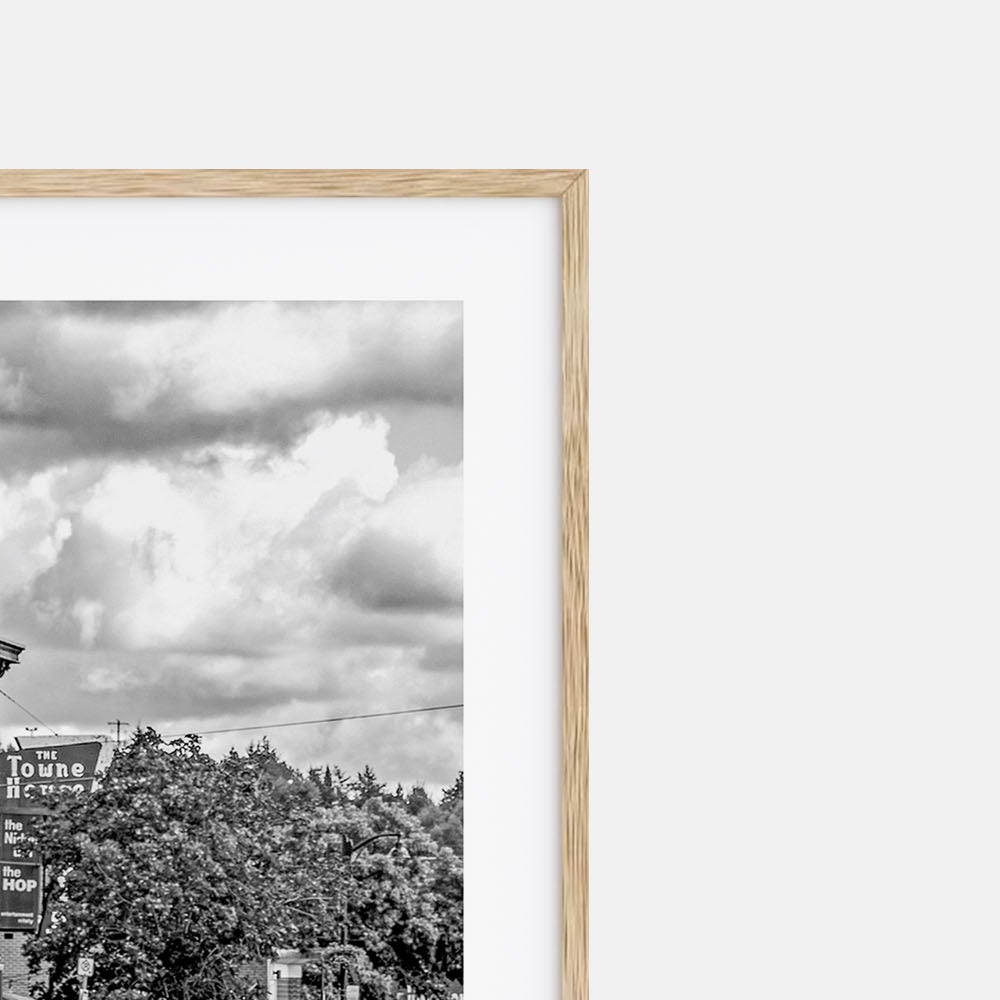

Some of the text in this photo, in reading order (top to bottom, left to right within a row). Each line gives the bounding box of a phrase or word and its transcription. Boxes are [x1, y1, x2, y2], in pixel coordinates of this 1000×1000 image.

[35, 751, 58, 760] THE
[6, 755, 84, 778] Towne
[4, 819, 23, 831] the
[2, 866, 21, 878] the
[2, 878, 37, 892] HOP
